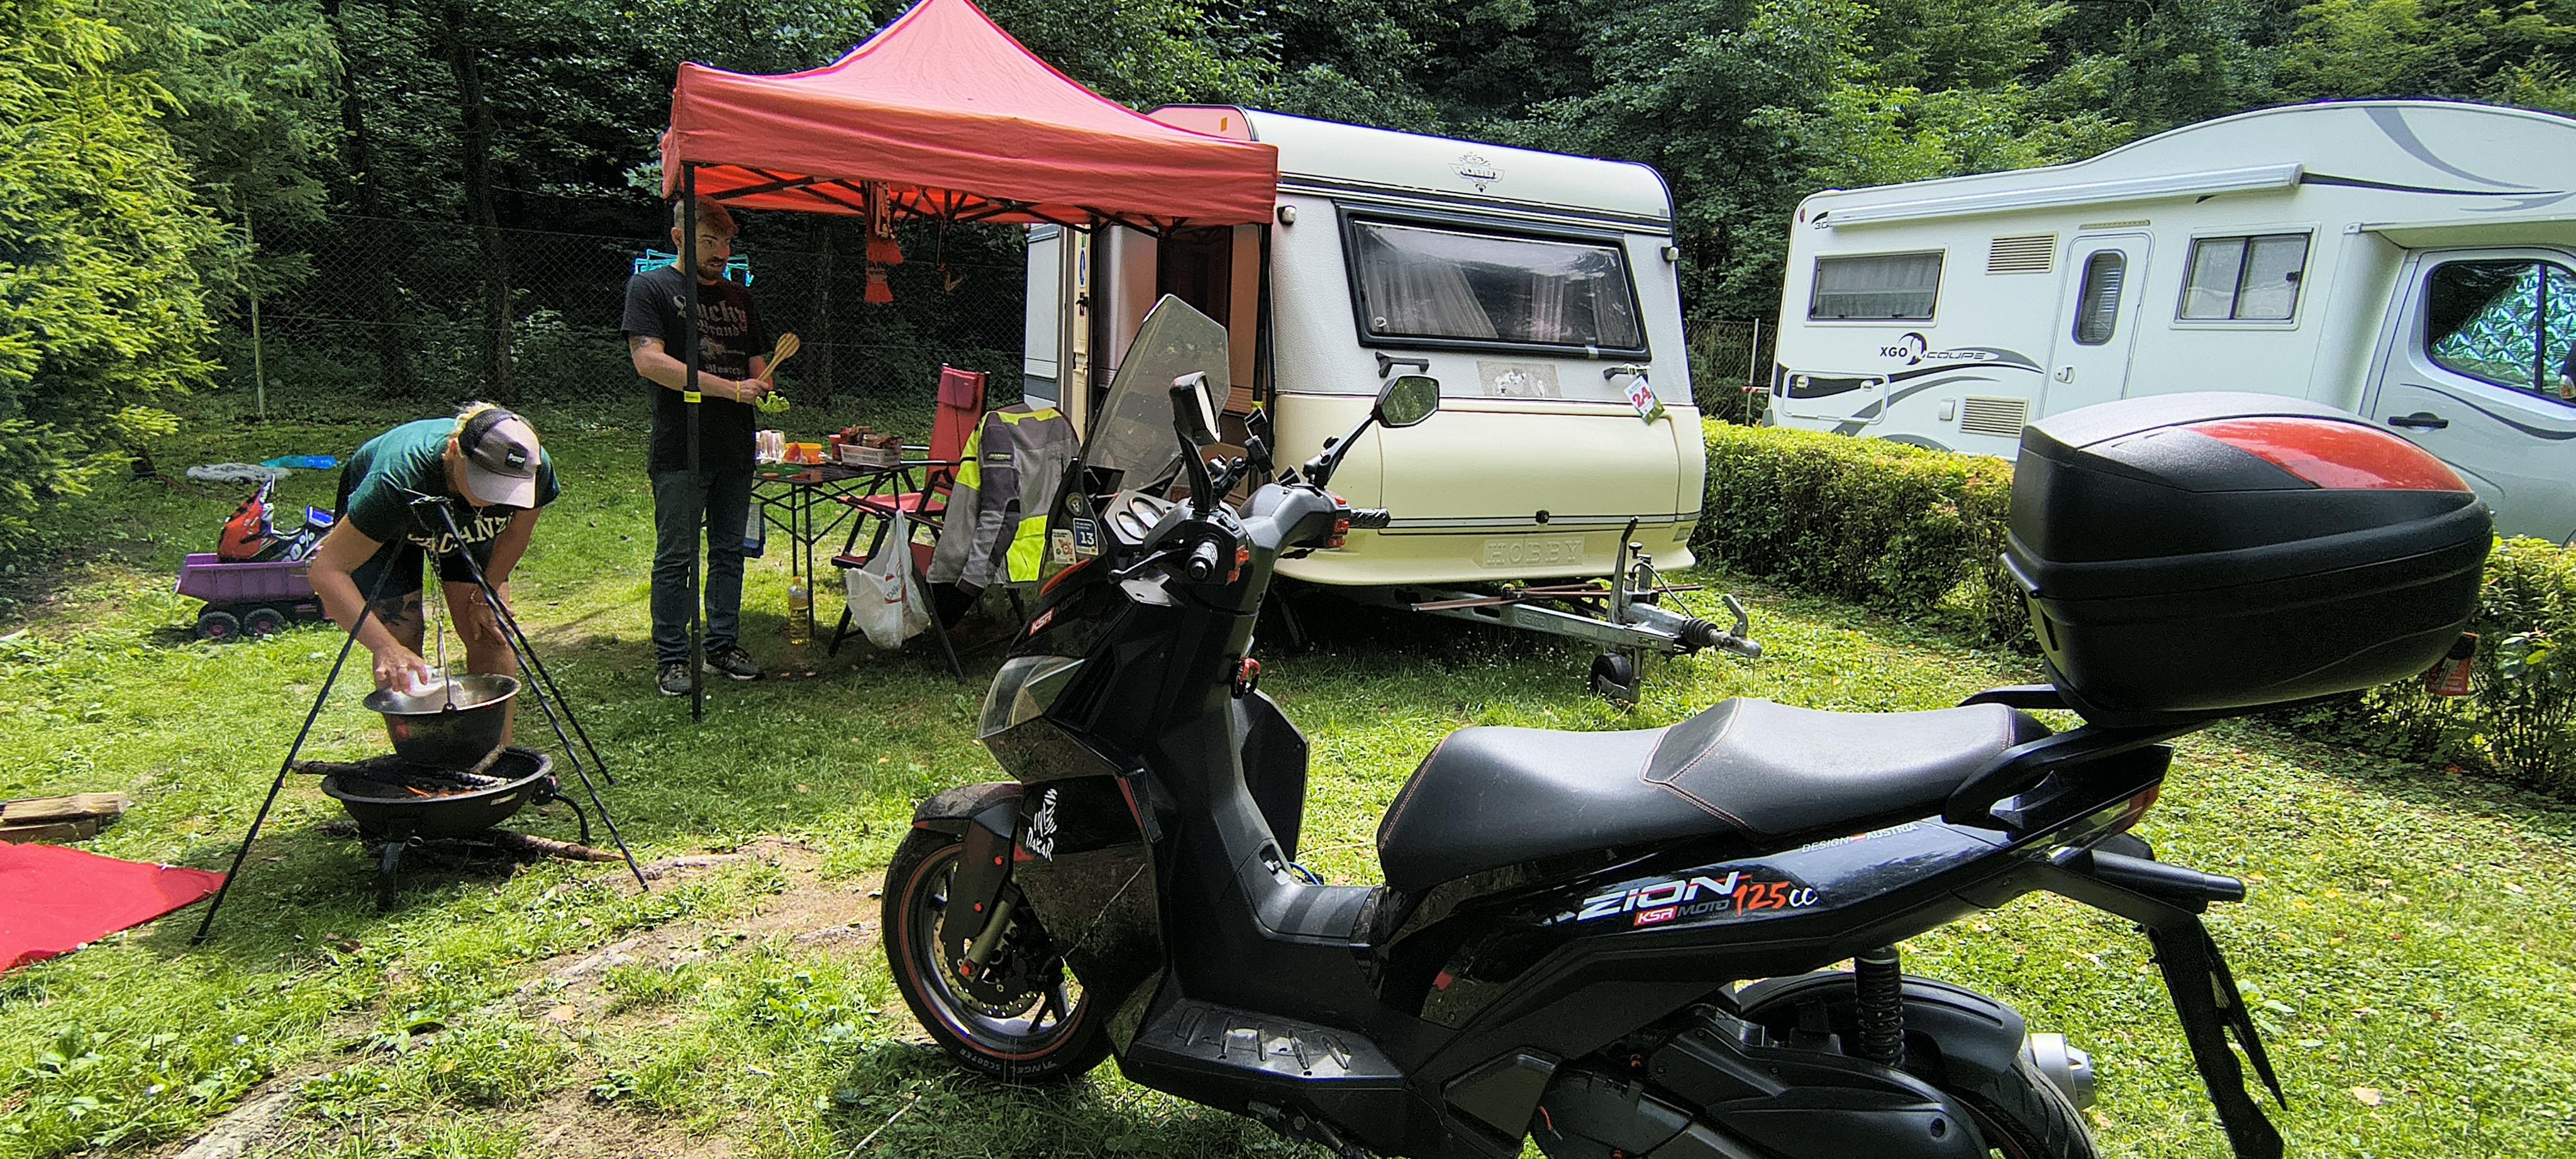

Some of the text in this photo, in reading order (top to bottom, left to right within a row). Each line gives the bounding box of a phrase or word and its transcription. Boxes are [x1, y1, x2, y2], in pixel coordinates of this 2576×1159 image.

[1880, 347, 1986, 360] XGO COUPE
[1632, 386, 1652, 408] 24
[1080, 531, 1094, 545] 13
[1486, 540, 1582, 565] HOBBY
[1030, 609, 1053, 635] KSR
[1026, 826, 1054, 862] DAKAR
[1801, 823, 1919, 853] DESIGN AUSTRIA
[1577, 871, 1740, 921] ZION
[1638, 899, 1730, 923] KSR MOTO
[960, 1048, 1002, 1070] SCOOTER
